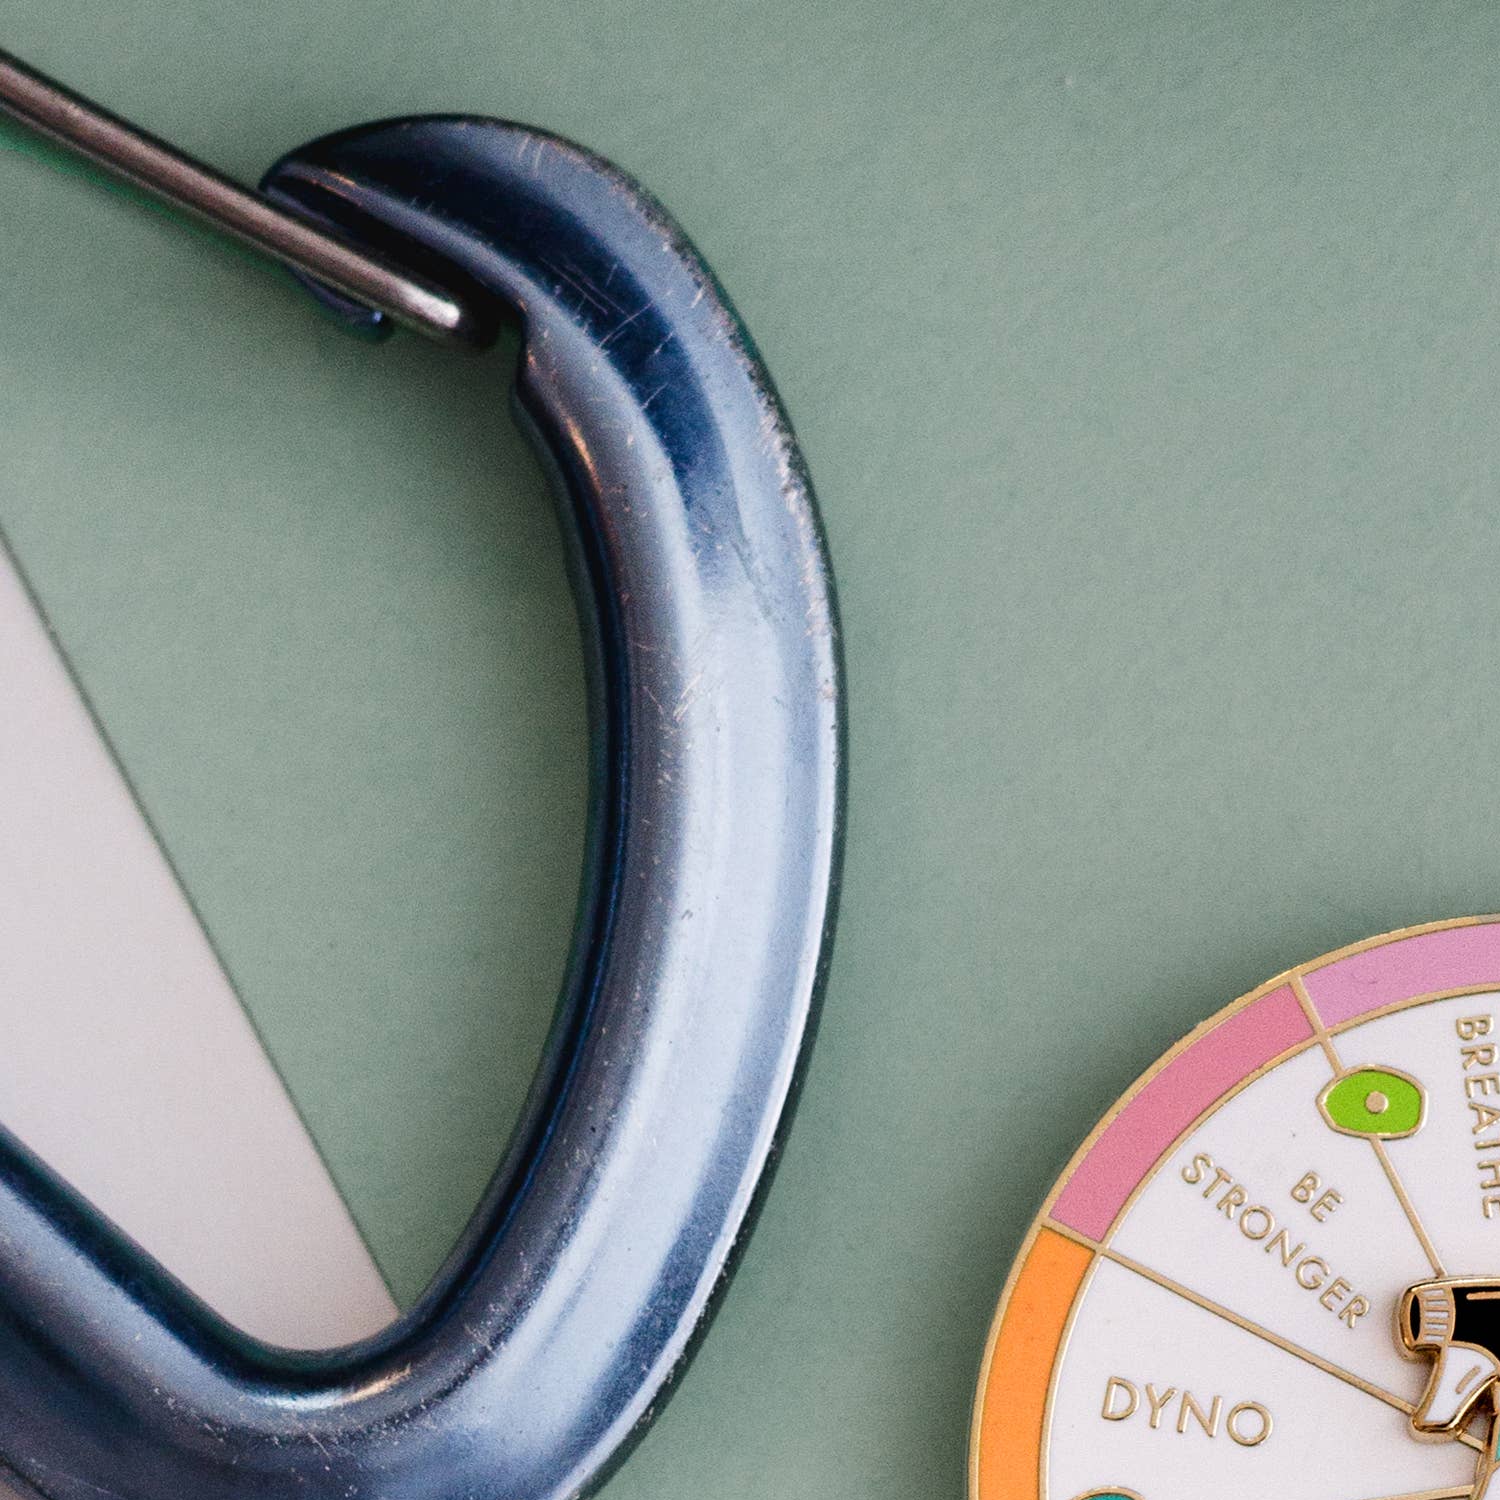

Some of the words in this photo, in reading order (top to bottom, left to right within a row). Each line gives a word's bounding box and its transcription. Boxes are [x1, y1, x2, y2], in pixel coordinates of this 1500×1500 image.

[1291, 1171, 1344, 1223] BE
[1182, 1153, 1371, 1329] STRONGER
[1102, 1376, 1273, 1447] DYNO
